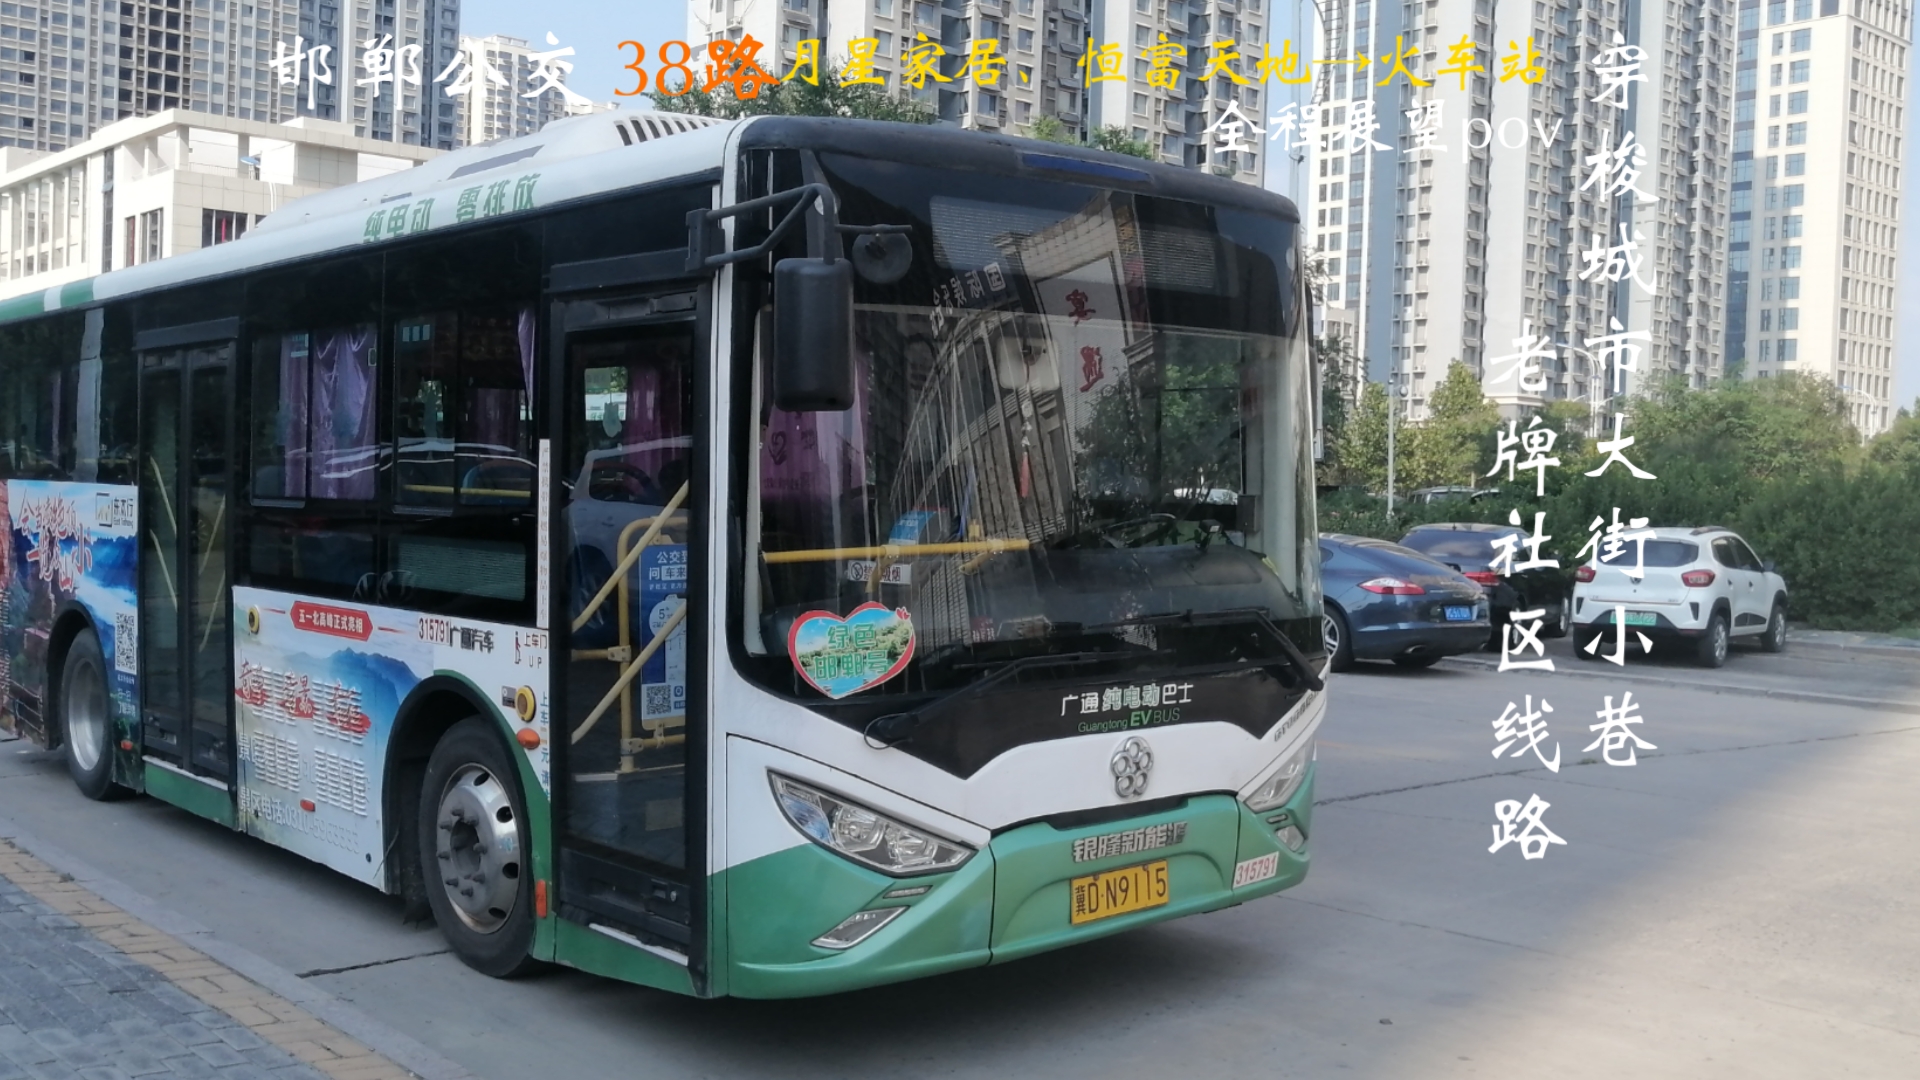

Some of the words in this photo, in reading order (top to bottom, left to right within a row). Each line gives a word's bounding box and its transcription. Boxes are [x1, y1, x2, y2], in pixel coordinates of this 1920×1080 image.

[363, 197, 436, 243] 纯电动
[456, 173, 542, 224] 零排放
[299, 609, 363, 634] 五一北高峰正式亮相
[419, 618, 450, 643] 315791
[524, 631, 548, 650] 上车门
[827, 623, 877, 650] 绿色
[814, 650, 889, 681] 邯郸号
[1061, 682, 1195, 716] 广通纯电动巴士
[1078, 719, 1128, 733] Guangtong
[1130, 709, 1152, 727] EV
[1153, 706, 1181, 724] BUS
[1073, 821, 1188, 863] 银隆新能源
[1235, 855, 1278, 886] 315791
